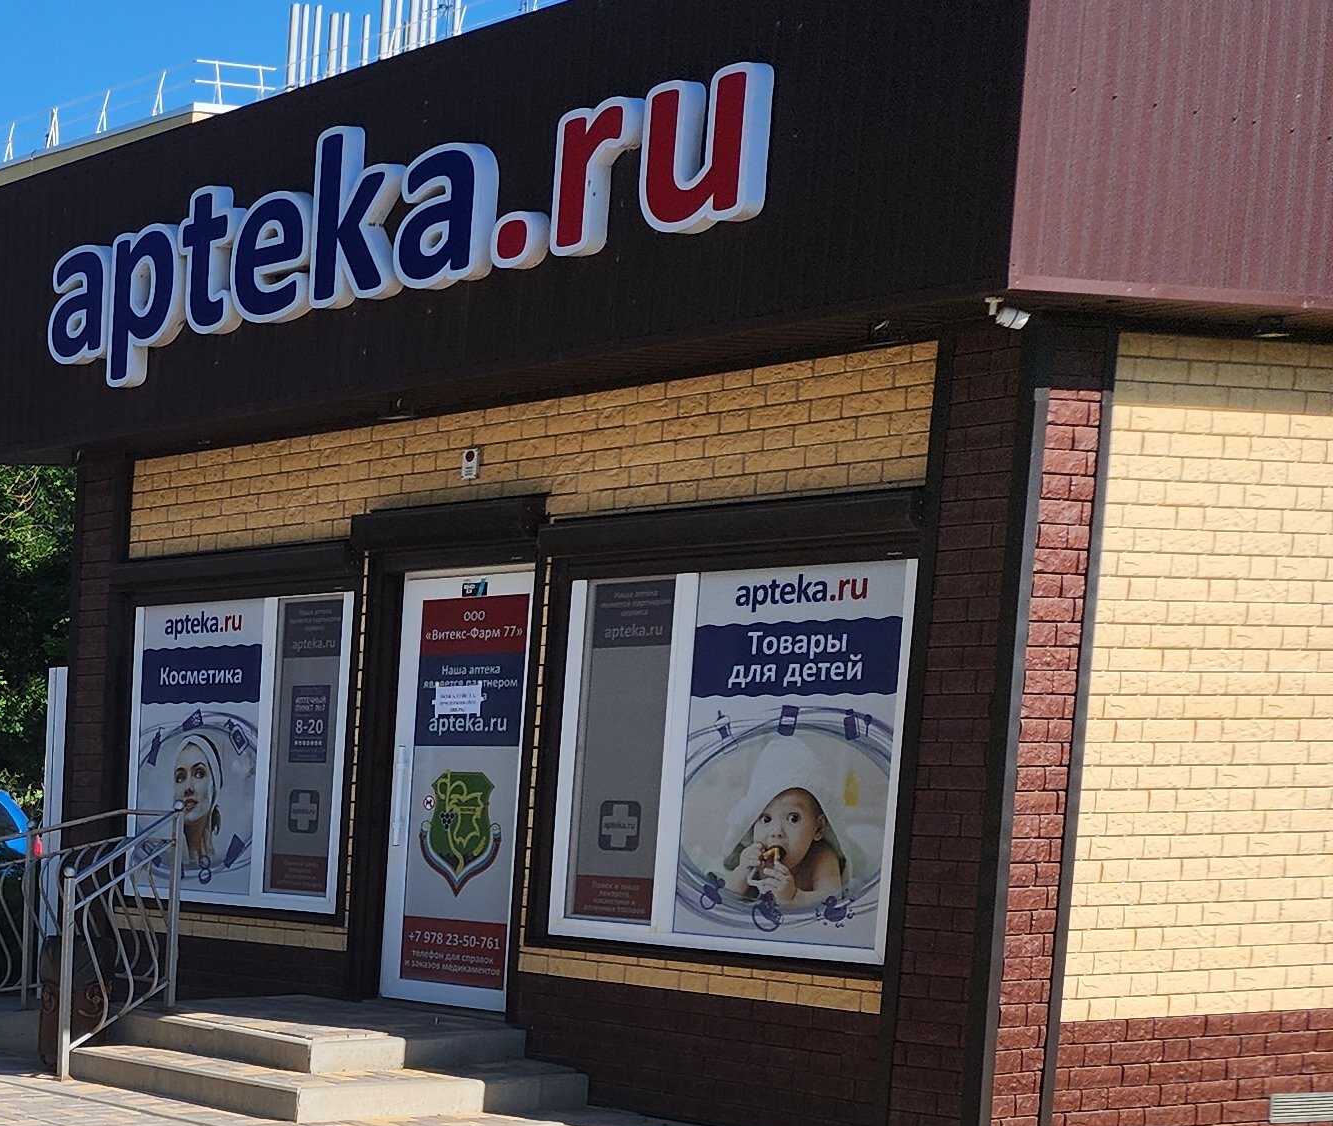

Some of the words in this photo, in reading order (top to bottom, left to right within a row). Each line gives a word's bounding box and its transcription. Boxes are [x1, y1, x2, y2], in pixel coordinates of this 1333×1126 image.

[49, 62, 775, 389] apteka.ru
[735, 574, 869, 613] apteka.ru
[463, 610, 486, 621] ООО
[164, 611, 243, 640] apteka.ru
[425, 627, 501, 641] «Витекс-Фарм
[503, 625, 523, 638] 77»
[604, 624, 663, 640] apteka.ru
[292, 638, 336, 653] apteka.ru
[747, 631, 848, 659] Товары
[160, 666, 243, 685] Косметика
[441, 665, 467, 675] Наша
[469, 665, 501, 675] аптека
[727, 664, 776, 689] для
[783, 653, 863, 687] детей
[295, 719, 324, 734] 8-20
[428, 713, 508, 736] apteka.ru
[408, 931, 421, 942] +7
[424, 931, 443, 944] 978
[446, 933, 500, 950] 23-50-761
